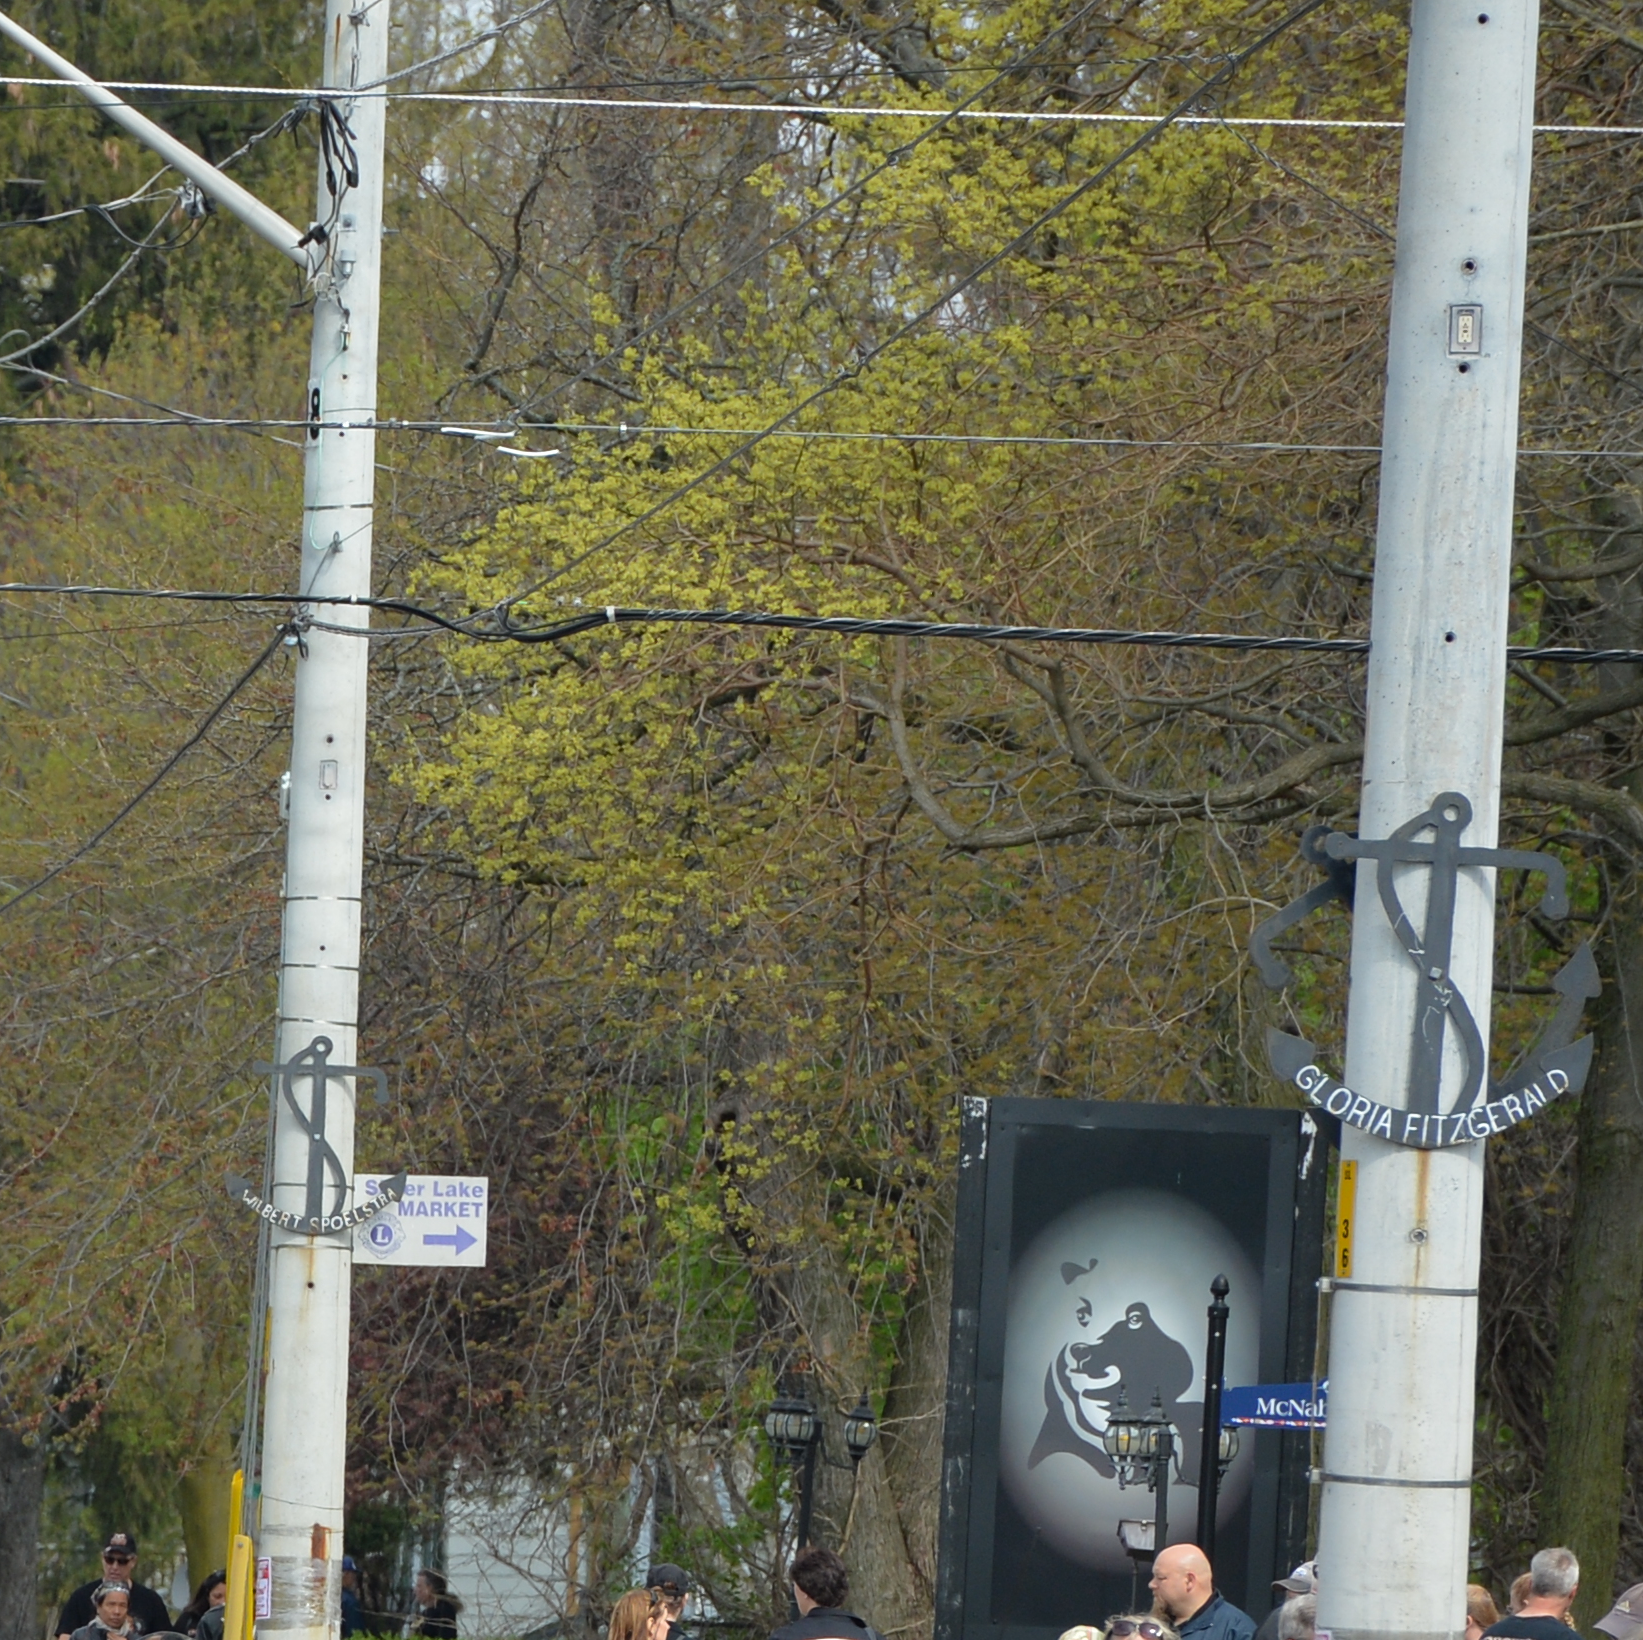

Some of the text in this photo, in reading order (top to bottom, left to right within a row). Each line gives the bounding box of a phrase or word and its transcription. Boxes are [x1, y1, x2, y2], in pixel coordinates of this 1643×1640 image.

[1295, 1064, 1392, 1139] GLORIA
[365, 1179, 484, 1198] Ser Lake
[243, 1188, 397, 1233] WILBERT SPOELSTRA
[398, 1200, 483, 1218] MARKET
